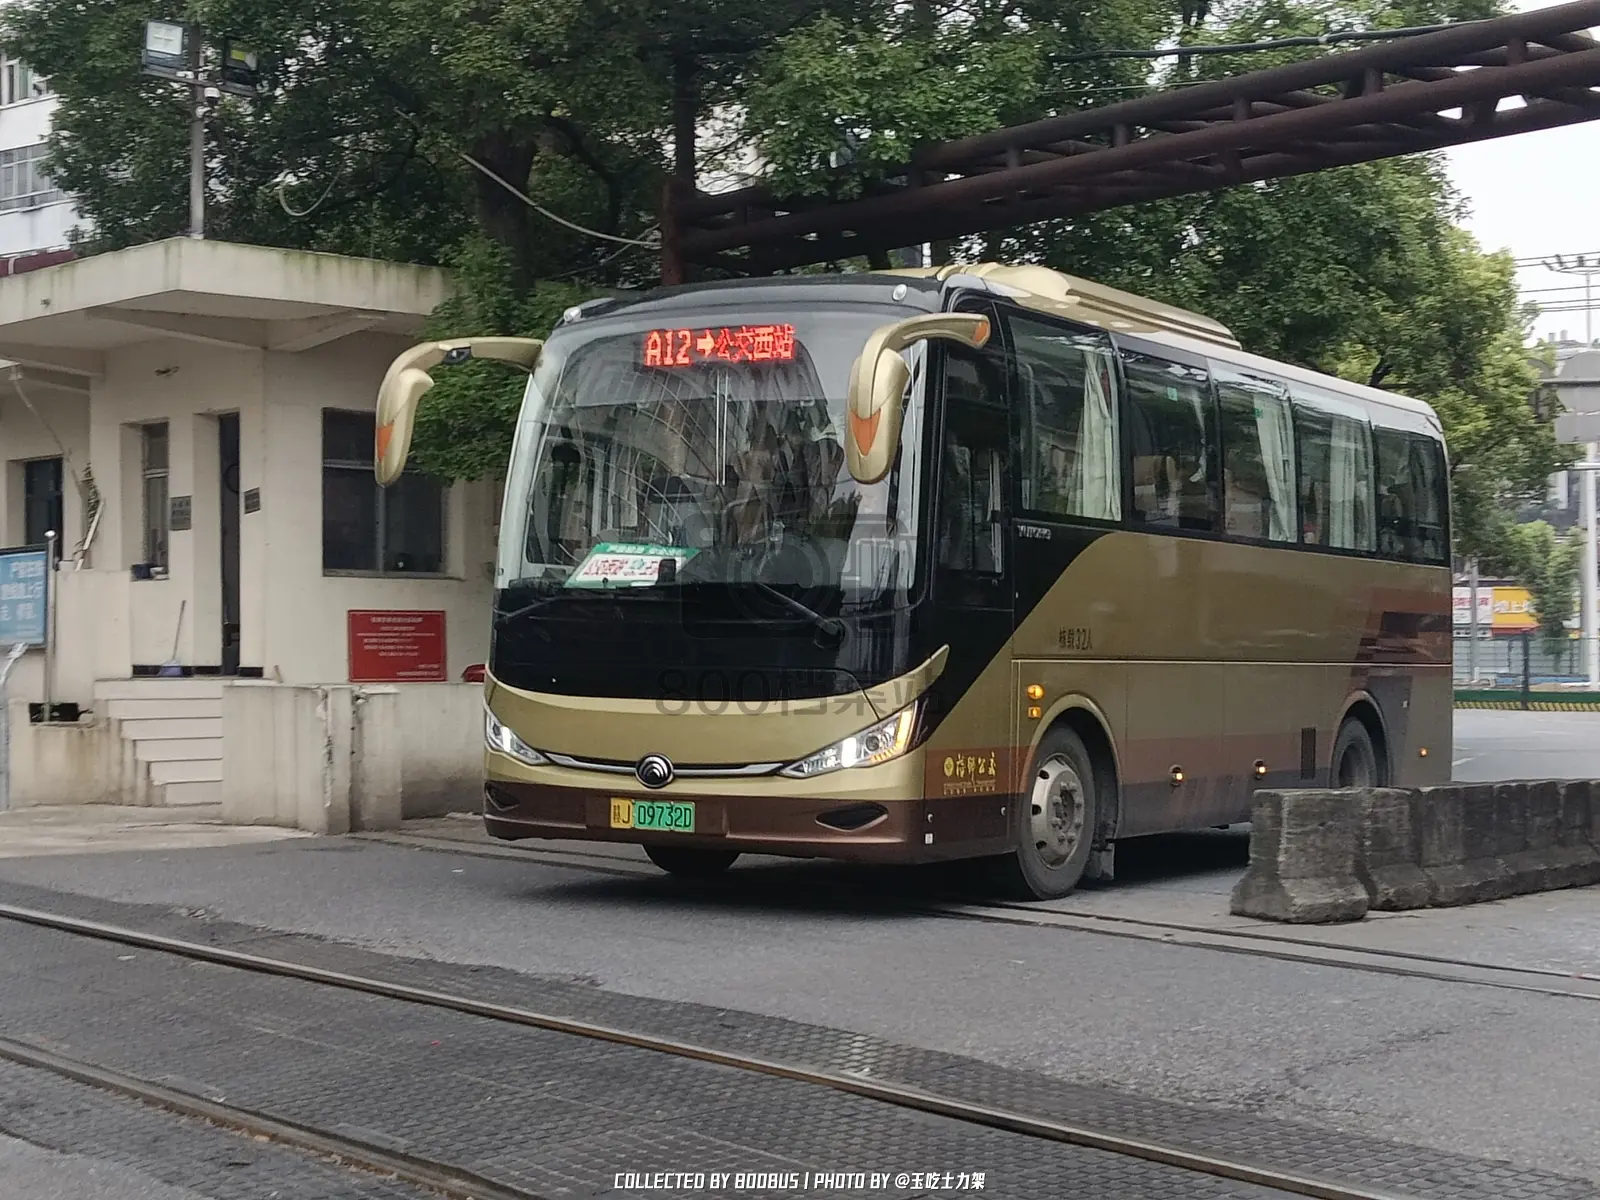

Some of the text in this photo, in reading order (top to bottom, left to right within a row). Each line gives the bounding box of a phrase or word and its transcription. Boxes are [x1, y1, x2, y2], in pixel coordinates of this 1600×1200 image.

[645, 329, 692, 366] A12
[715, 323, 796, 362] 公交西站
